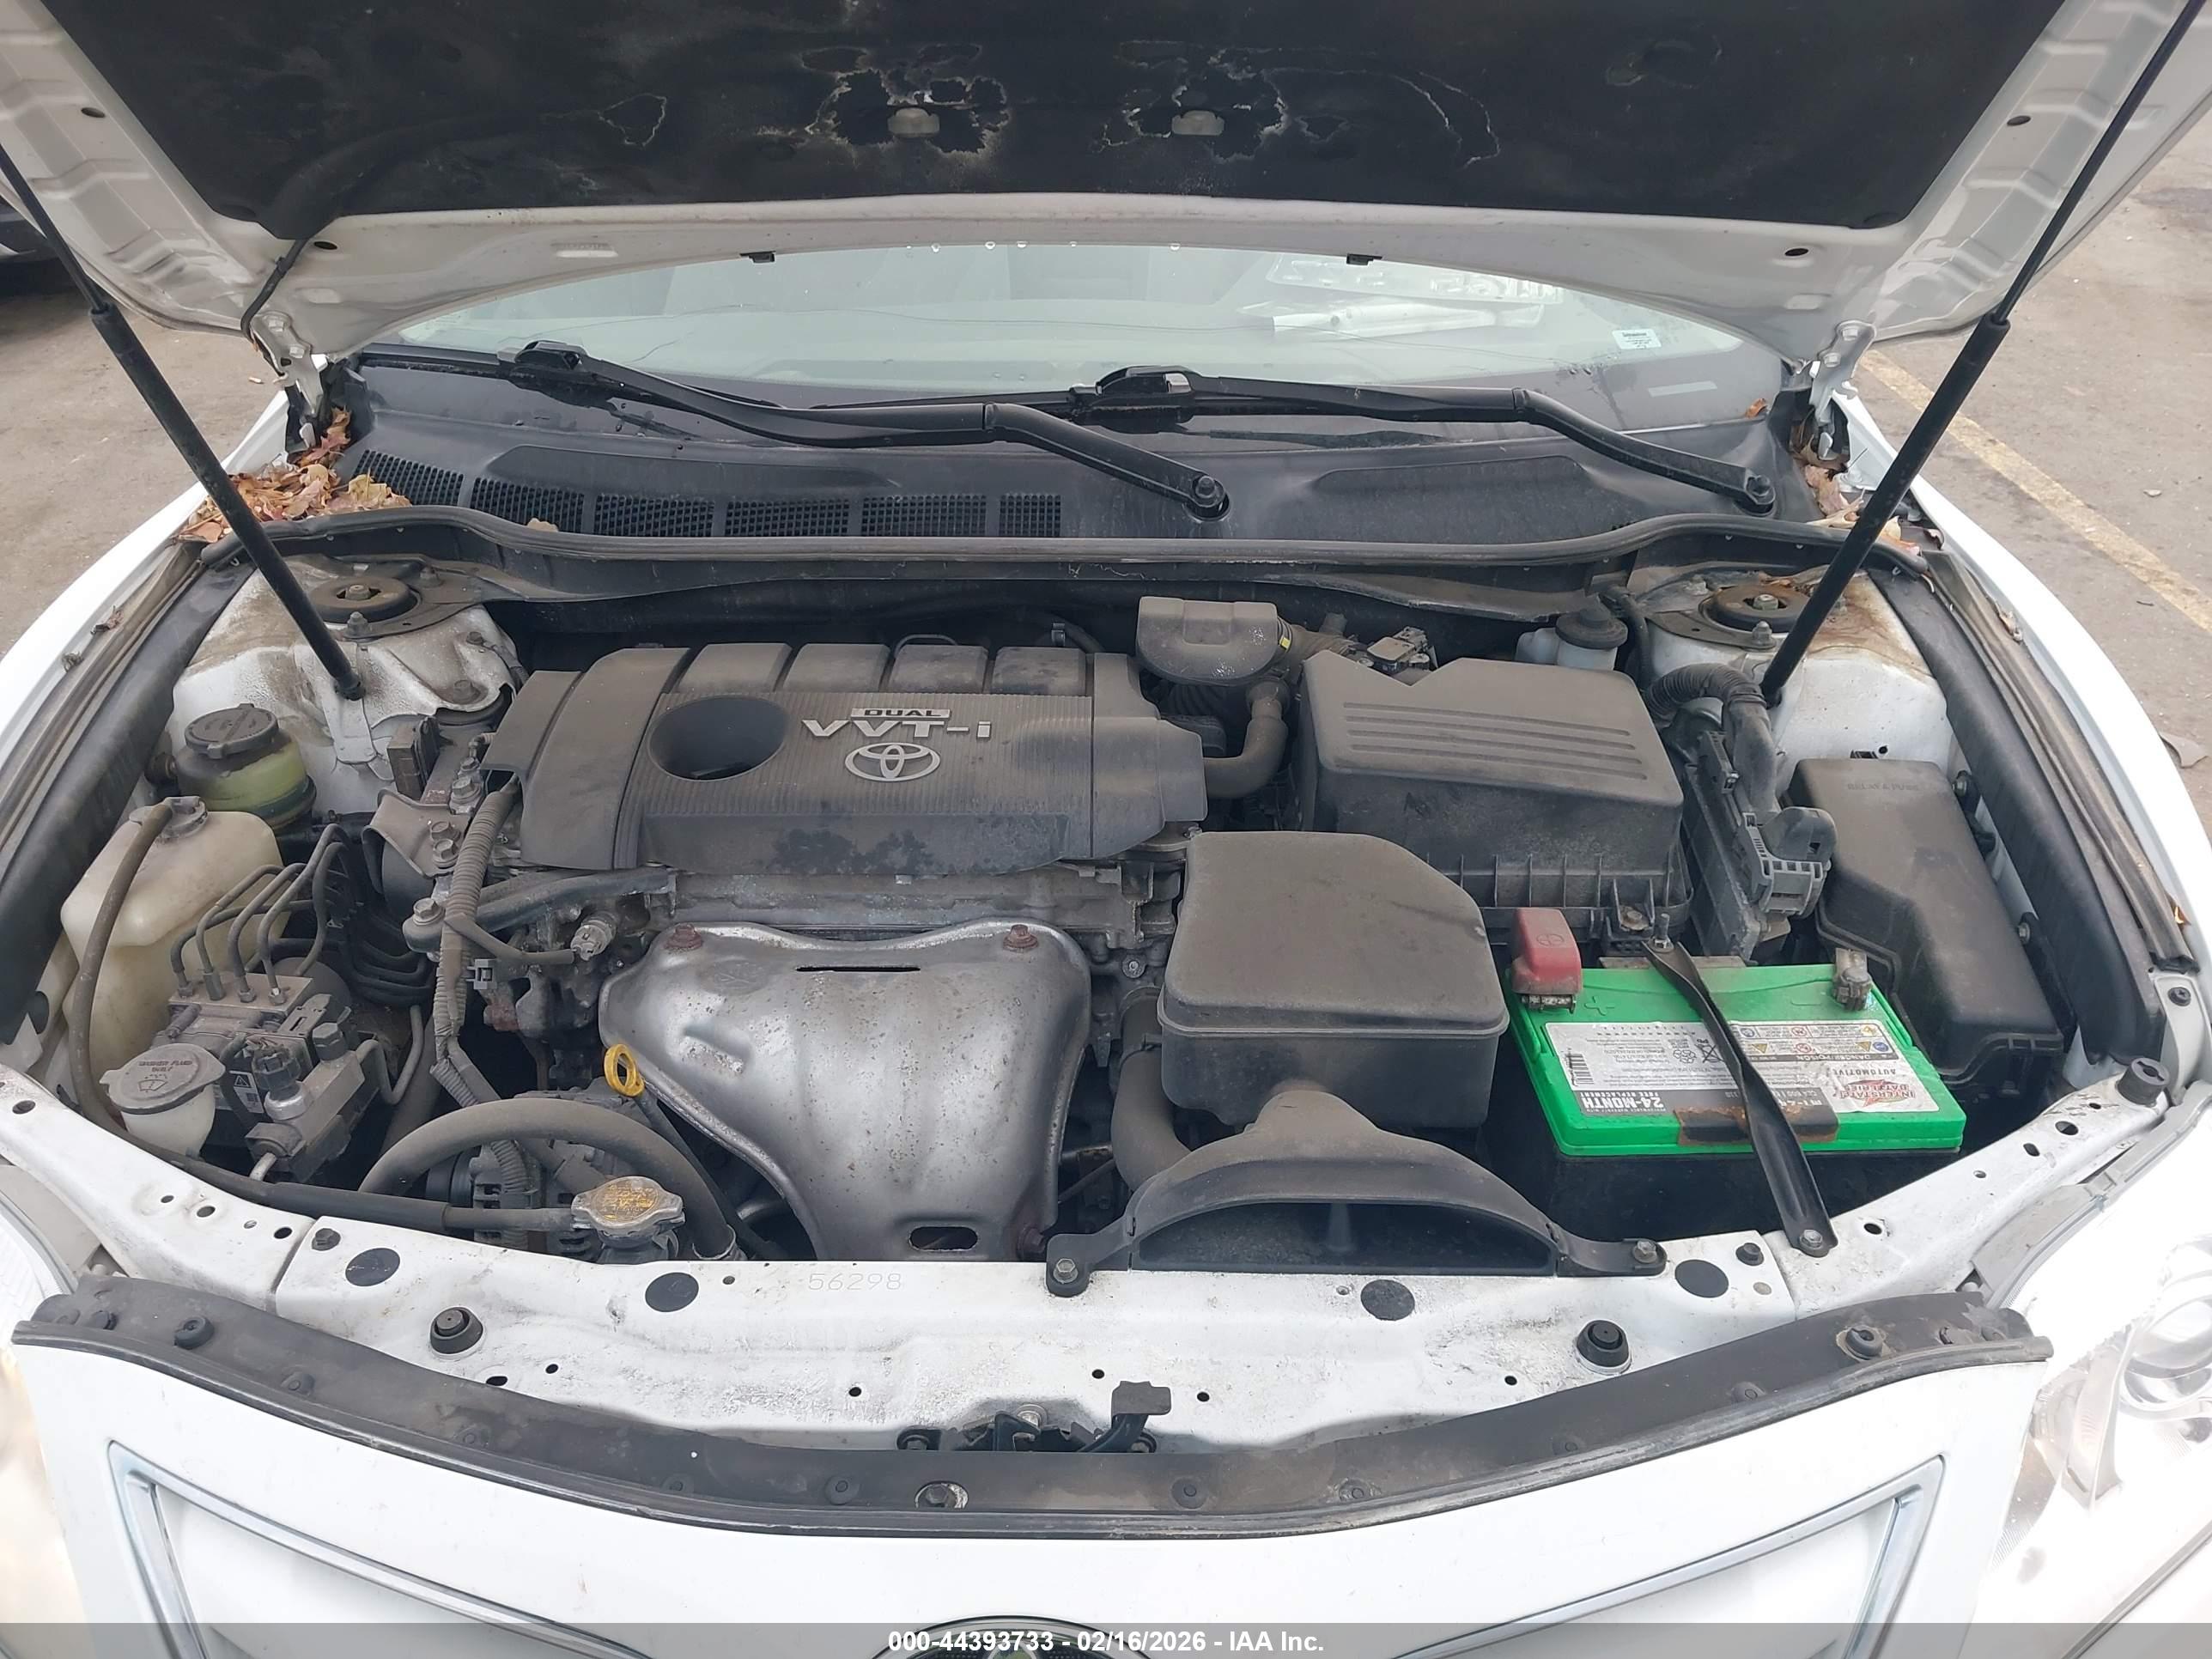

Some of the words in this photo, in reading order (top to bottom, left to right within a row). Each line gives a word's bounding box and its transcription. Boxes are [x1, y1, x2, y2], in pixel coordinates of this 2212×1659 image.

[802, 720, 991, 738] VVT-i
[1839, 1091, 1915, 1099] INTERSTATE
[1581, 1097, 1664, 1109] 24-MONTH
[808, 1273, 901, 1290] 56298
